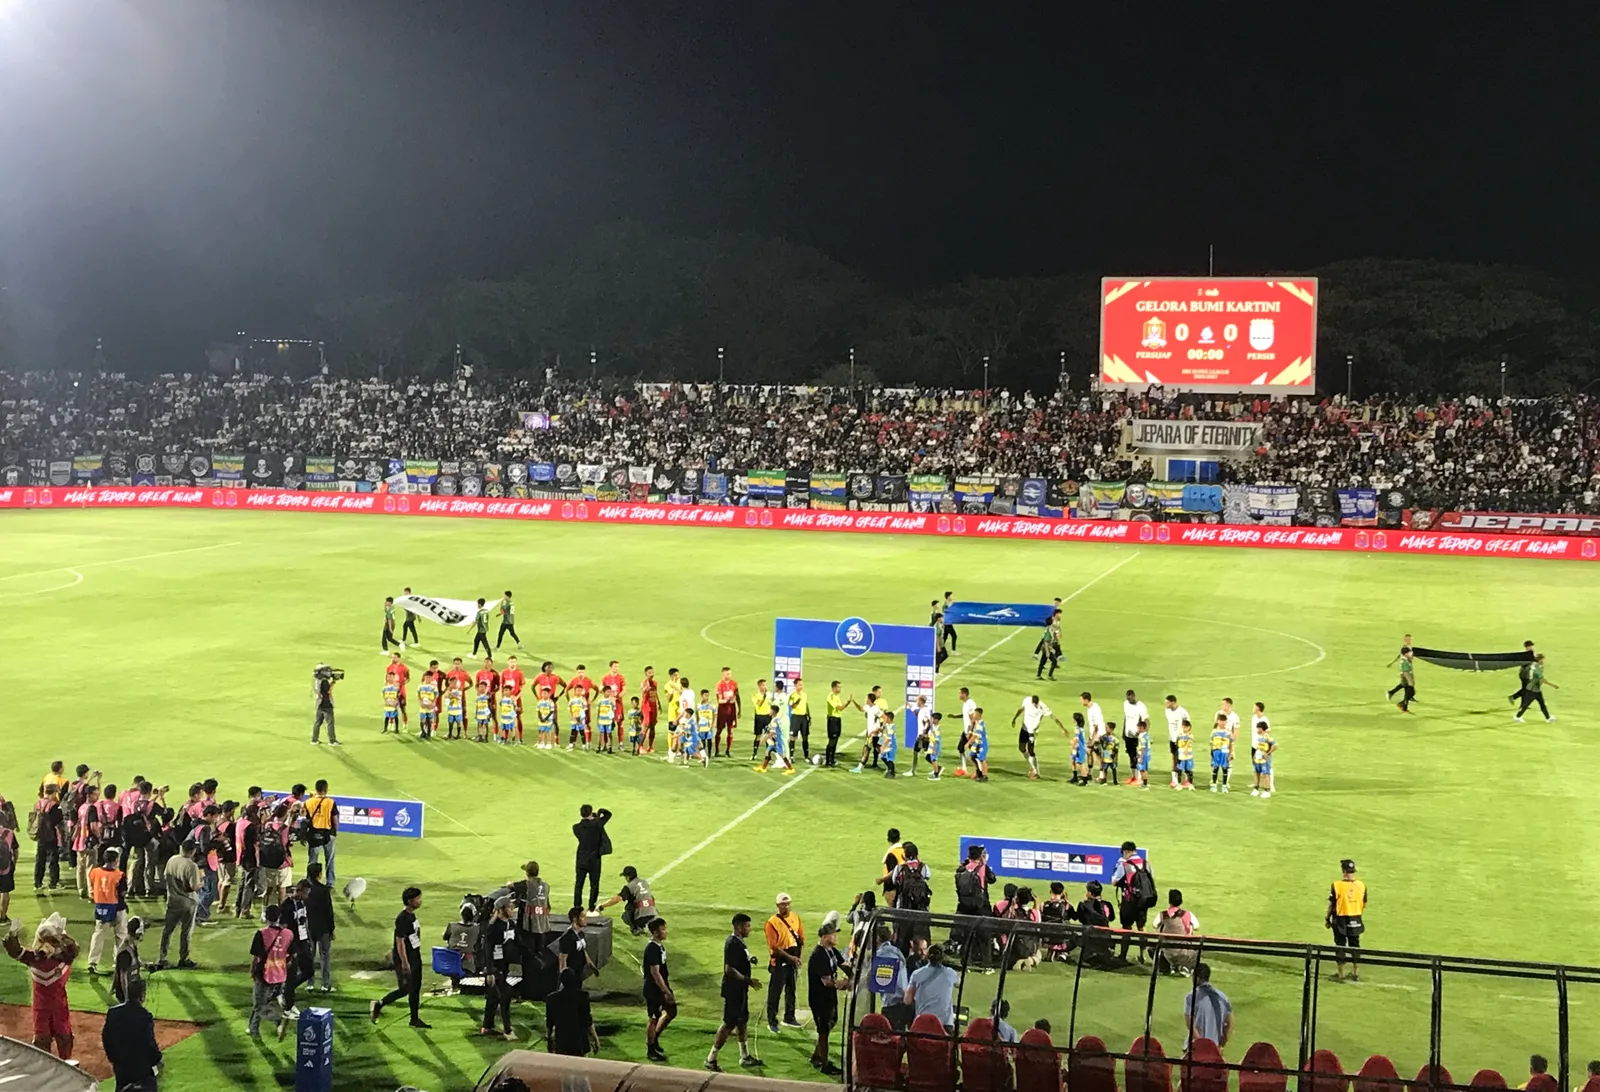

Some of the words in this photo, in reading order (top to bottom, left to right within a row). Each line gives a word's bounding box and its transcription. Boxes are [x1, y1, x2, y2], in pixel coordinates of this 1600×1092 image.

[1136, 301, 1187, 312] GELORA
[1190, 301, 1224, 312] BUMI
[1226, 301, 1280, 312] KARTINI
[1175, 323, 1189, 341] 0
[1224, 323, 1238, 341] 0
[1136, 351, 1172, 359] PERSIJAP
[1187, 349, 1224, 360] 00:00
[1247, 352, 1275, 360] PERSIB
[1136, 424, 1181, 444] JEPARA
[1184, 425, 1199, 444] OF
[1202, 425, 1257, 445] ETERNITY
[64, 490, 95, 502] MAKE
[138, 491, 169, 503] GREAT
[247, 494, 274, 505] MAKE
[312, 495, 342, 507] GREAT
[419, 500, 448, 511] MAKE
[487, 502, 518, 514] GREAT
[598, 506, 628, 518] MAKE
[668, 507, 701, 521] GREAT
[784, 511, 815, 524] MAKE
[856, 515, 892, 528] GREAT
[977, 520, 1010, 533] MAKE
[1054, 522, 1093, 536] GREAT
[1182, 527, 1218, 541] MAKE
[1263, 530, 1305, 544] GREAT
[1399, 535, 1438, 549] MAKE
[1485, 539, 1529, 553] GREAT
